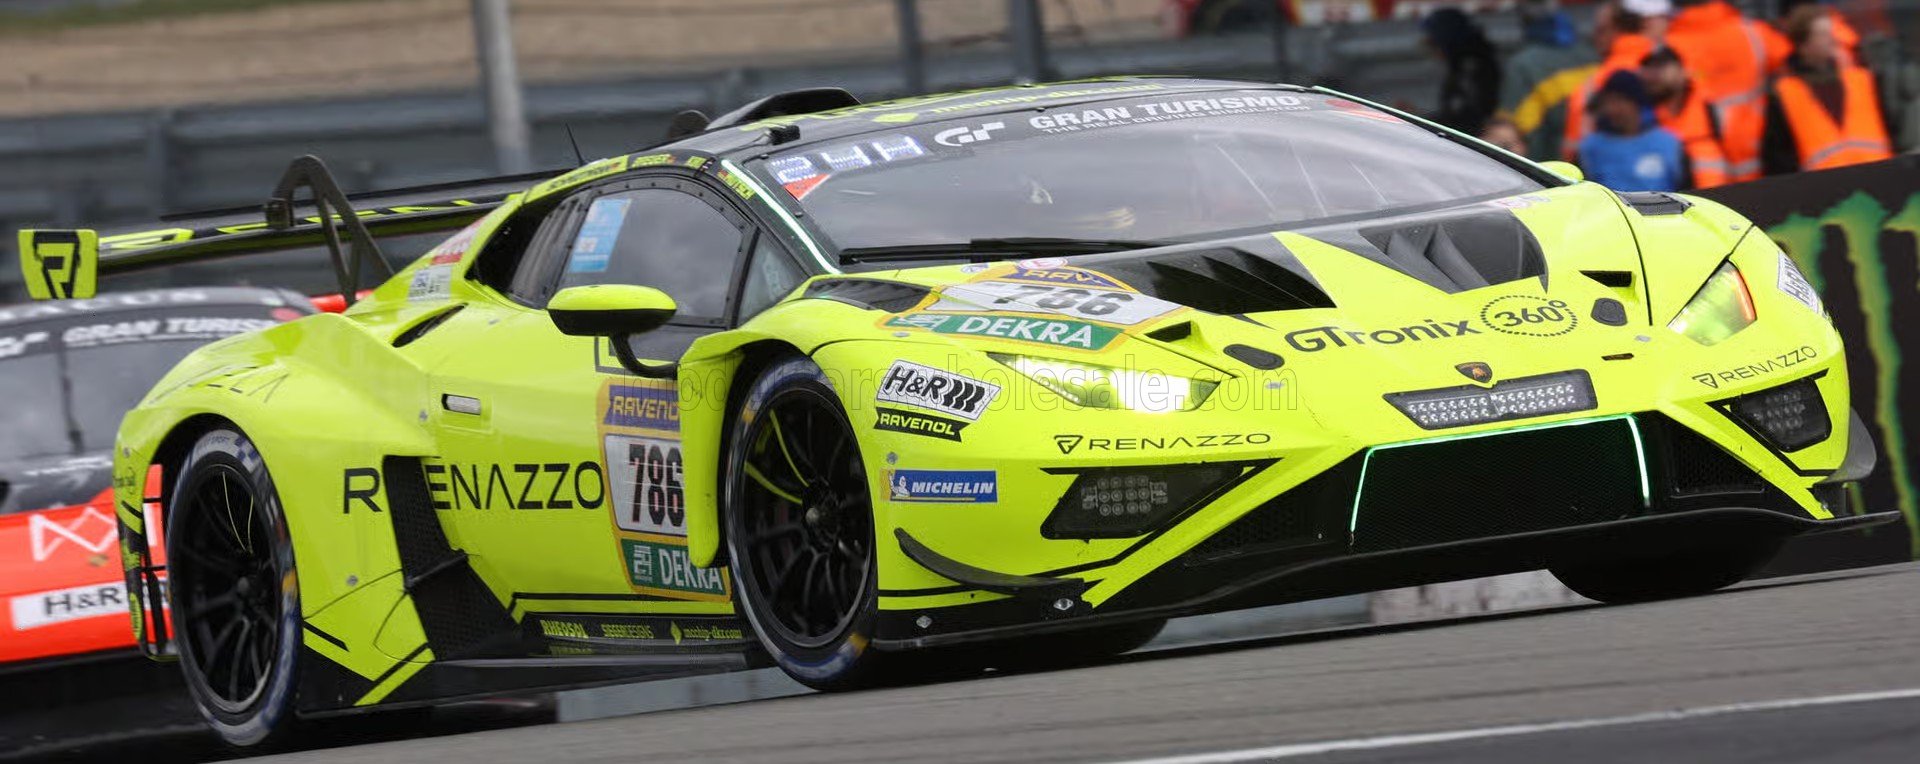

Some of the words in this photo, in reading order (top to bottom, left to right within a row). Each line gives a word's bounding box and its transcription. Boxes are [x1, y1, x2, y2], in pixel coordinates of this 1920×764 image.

[1029, 106, 1132, 130] GRAN
[1136, 95, 1302, 116] TURISMO
[1042, 123, 1080, 135] THE
[1080, 119, 1129, 132] REAL
[993, 285, 1134, 316] 786
[956, 315, 1093, 349] DEKRA
[1283, 318, 1484, 353] GTronix
[1717, 346, 1818, 382] RENAZZO
[884, 366, 948, 400] H&R
[613, 395, 680, 421] RAVENO
[879, 412, 956, 436] RAVENOL
[1088, 433, 1271, 451] RENAZZO
[342, 460, 605, 514] RENAZZO
[628, 442, 686, 528] 786
[911, 481, 994, 494] MICHELIN
[44, 586, 123, 617] H&R
